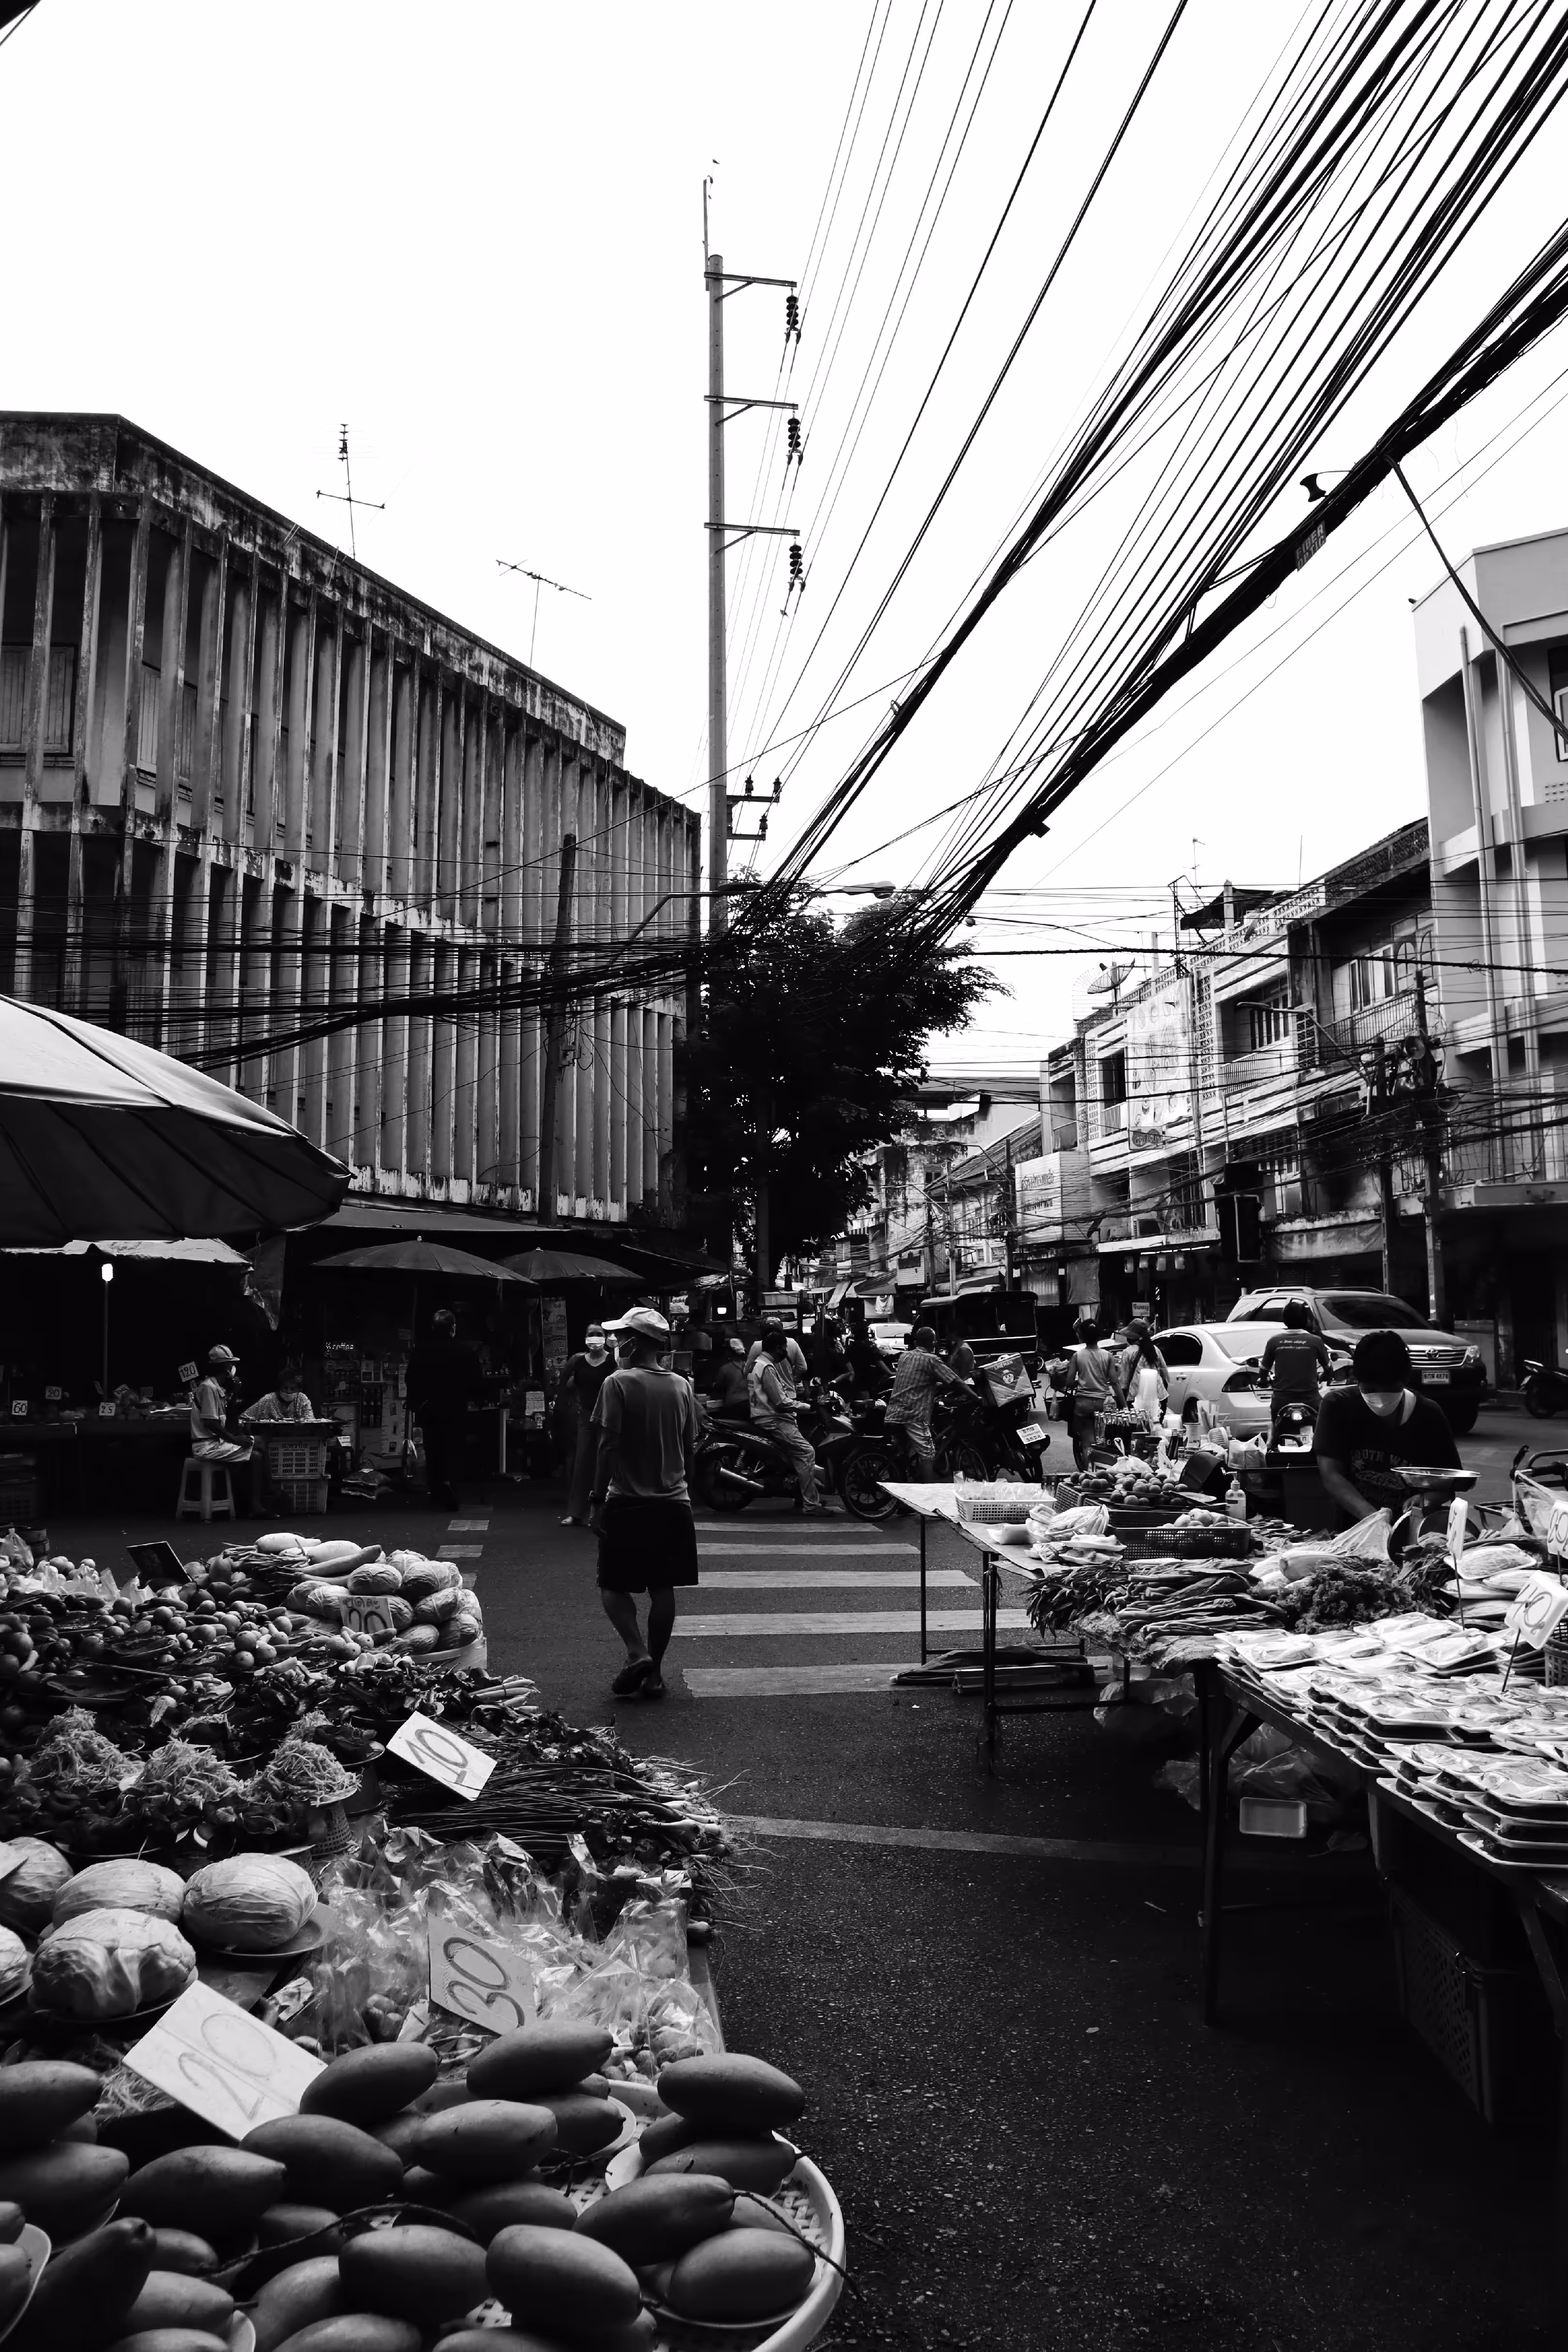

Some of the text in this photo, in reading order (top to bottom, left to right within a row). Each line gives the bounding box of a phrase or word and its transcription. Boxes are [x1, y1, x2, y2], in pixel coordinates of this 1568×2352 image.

[1296, 524, 1324, 559] FIBER
[1297, 535, 1326, 571] OPTIC
[180, 1365, 196, 1378] 120
[14, 1402, 27, 1414] 60
[47, 1388, 60, 1398] 20
[101, 1405, 114, 1414] 25
[405, 1729, 468, 1785] 10
[442, 1935, 527, 2028] 30
[178, 2011, 283, 2121] 20
